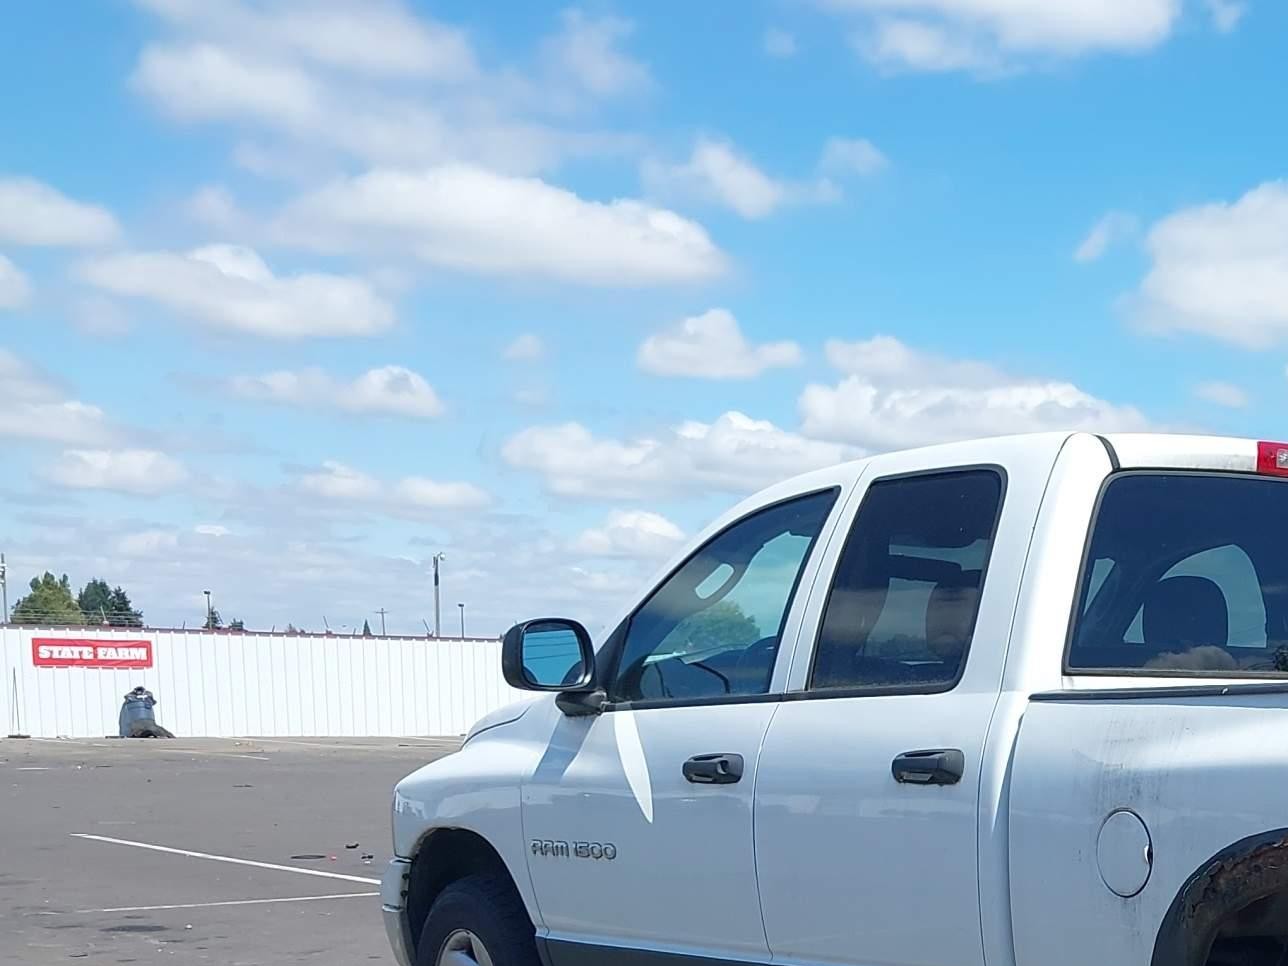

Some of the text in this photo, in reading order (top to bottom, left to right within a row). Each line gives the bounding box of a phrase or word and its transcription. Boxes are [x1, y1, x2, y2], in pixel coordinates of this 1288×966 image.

[38, 645, 148, 661] STATE FARM
[531, 839, 617, 860] RAM 1500
